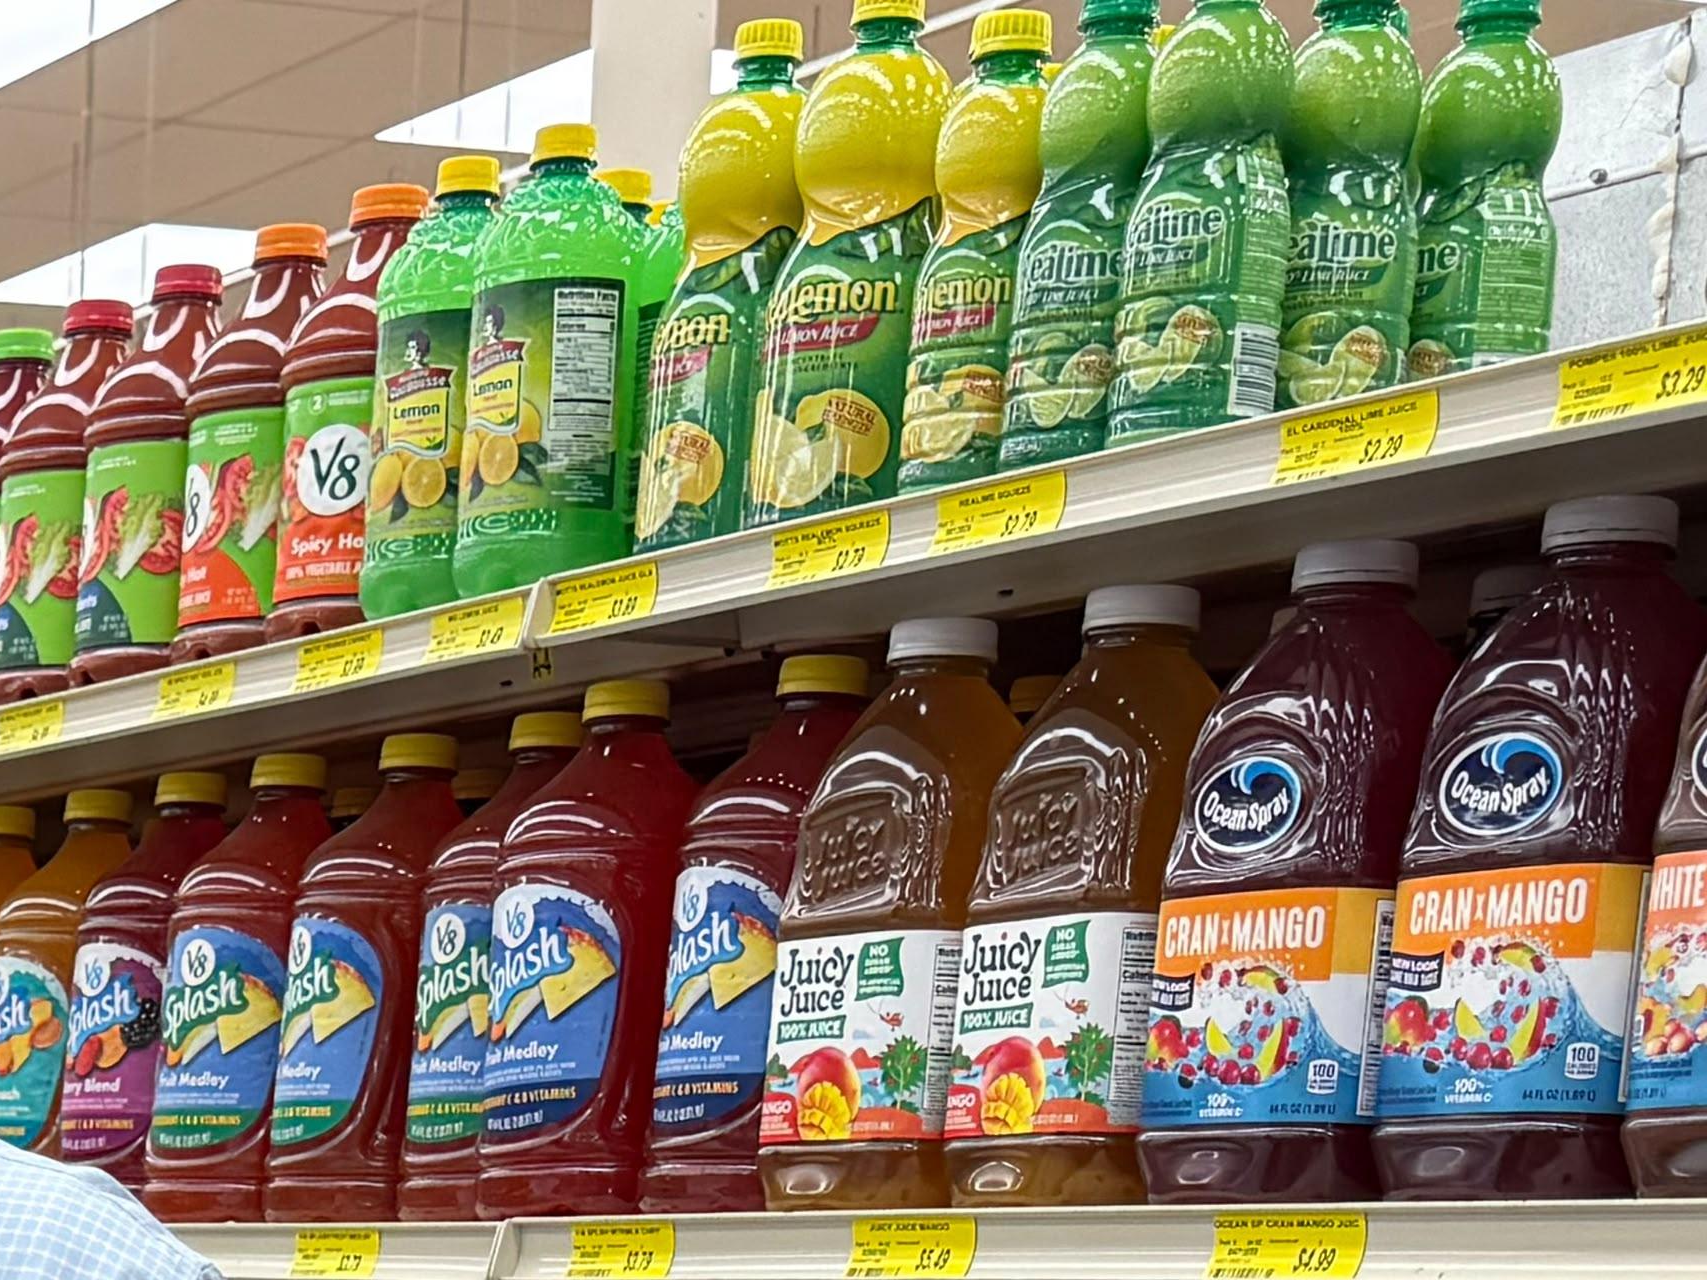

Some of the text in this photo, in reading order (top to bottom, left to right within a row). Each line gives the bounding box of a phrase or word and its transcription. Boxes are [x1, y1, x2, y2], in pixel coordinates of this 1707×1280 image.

[473, 377, 512, 397] Lemon
[1655, 366, 1706, 399] $3.29
[393, 403, 440, 420] Lemon
[1287, 402, 1417, 437] EL CARDENAL LIME JUICE
[1359, 435, 1403, 465] $2.29
[309, 437, 361, 502] V8
[291, 534, 335, 557] Spicy
[1450, 772, 1548, 814] Ocean Spray
[1204, 790, 1287, 833] Ocean Spray
[1412, 877, 1588, 936] CRAN MANGO
[505, 904, 527, 937] V8
[1165, 904, 1326, 960] CRAN MANGO
[436, 922, 459, 955] V8
[1055, 929, 1076, 941] NO
[186, 950, 209, 976] V8
[868, 945, 890, 957] NO
[964, 930, 1042, 977] Juicy
[487, 924, 567, 1010] Splash
[779, 940, 855, 989] Juicy
[964, 972, 1033, 1002] Juice
[164, 965, 242, 1037] Splash
[780, 985, 846, 1017] Juice
[808, 1018, 846, 1039] JUICE
[962, 1007, 1031, 1029] 100% JUICE
[503, 1041, 559, 1063] Medley
[670, 1032, 723, 1053] Medley
[1569, 1046, 1596, 1065] 100
[432, 1058, 482, 1077] Medley
[1311, 1062, 1336, 1079] 100
[83, 1077, 120, 1095] Blend
[179, 1072, 229, 1091] Medley
[919, 1222, 950, 1233] MANGO
[1214, 1218, 1335, 1229] OCEAN CRAN MANGO
[1293, 1247, 1336, 1274] $4.99
